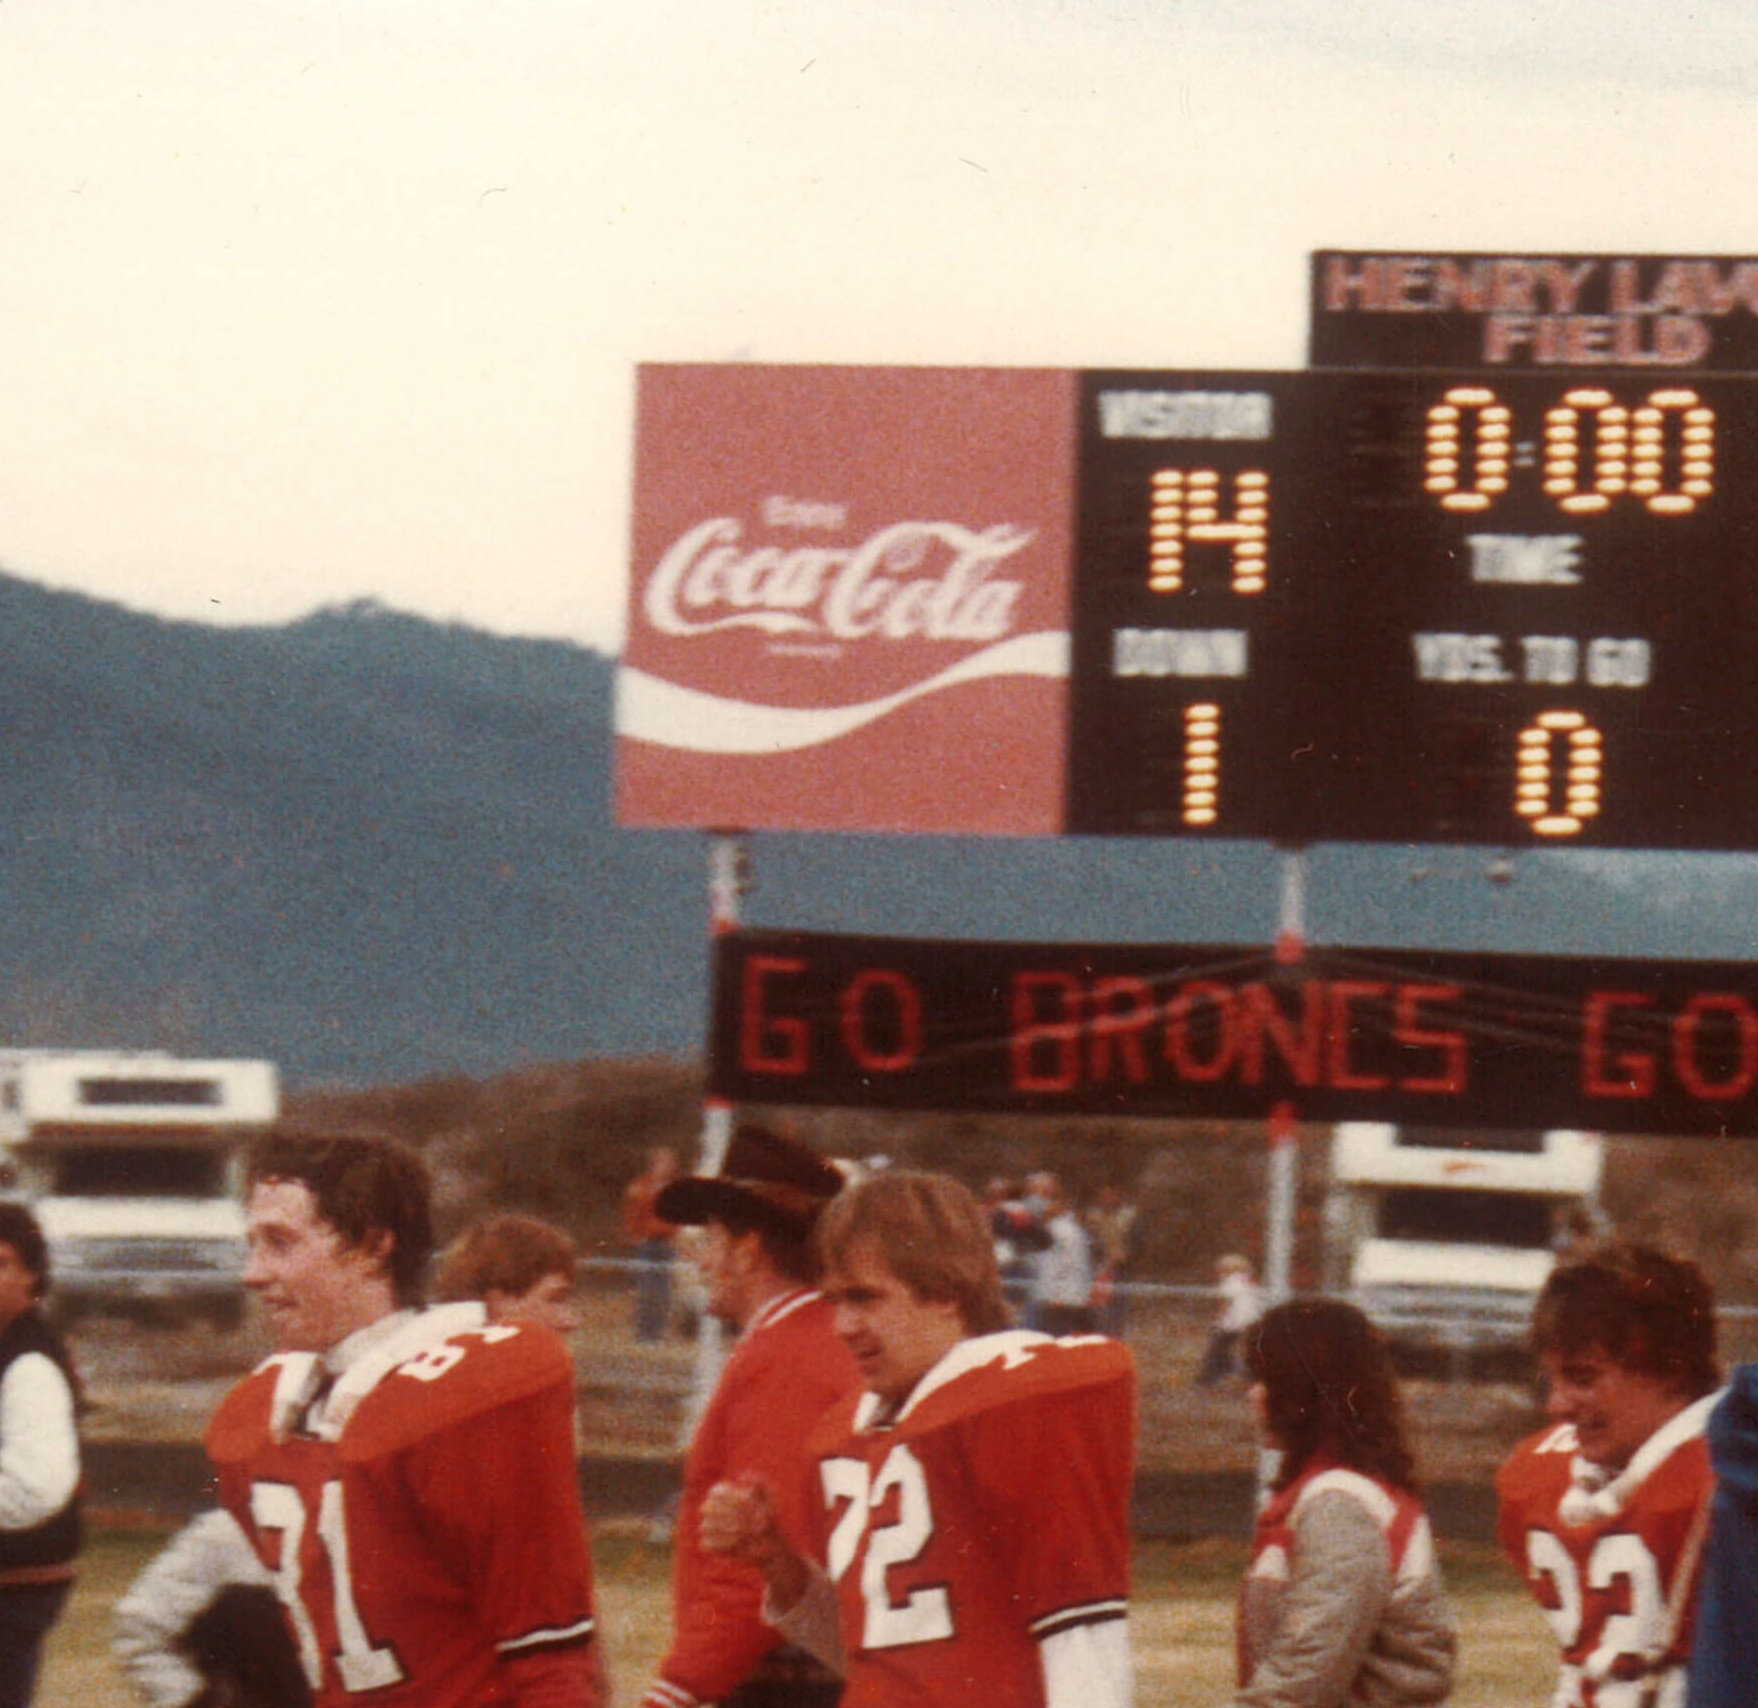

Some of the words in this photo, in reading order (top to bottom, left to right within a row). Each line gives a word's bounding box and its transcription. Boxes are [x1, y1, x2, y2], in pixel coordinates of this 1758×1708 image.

[1322, 255, 1594, 313] HENRY
[1482, 311, 1710, 365] FIELD
[1423, 386, 1717, 514] 0:00
[642, 514, 1040, 640] Coca-Cola
[1148, 468, 1269, 593] 14
[1181, 700, 1219, 827] 1
[1514, 710, 1603, 838] 0
[740, 956, 924, 1076] GO
[1010, 970, 1469, 1095] BRONCS
[818, 1442, 955, 1650] 72
